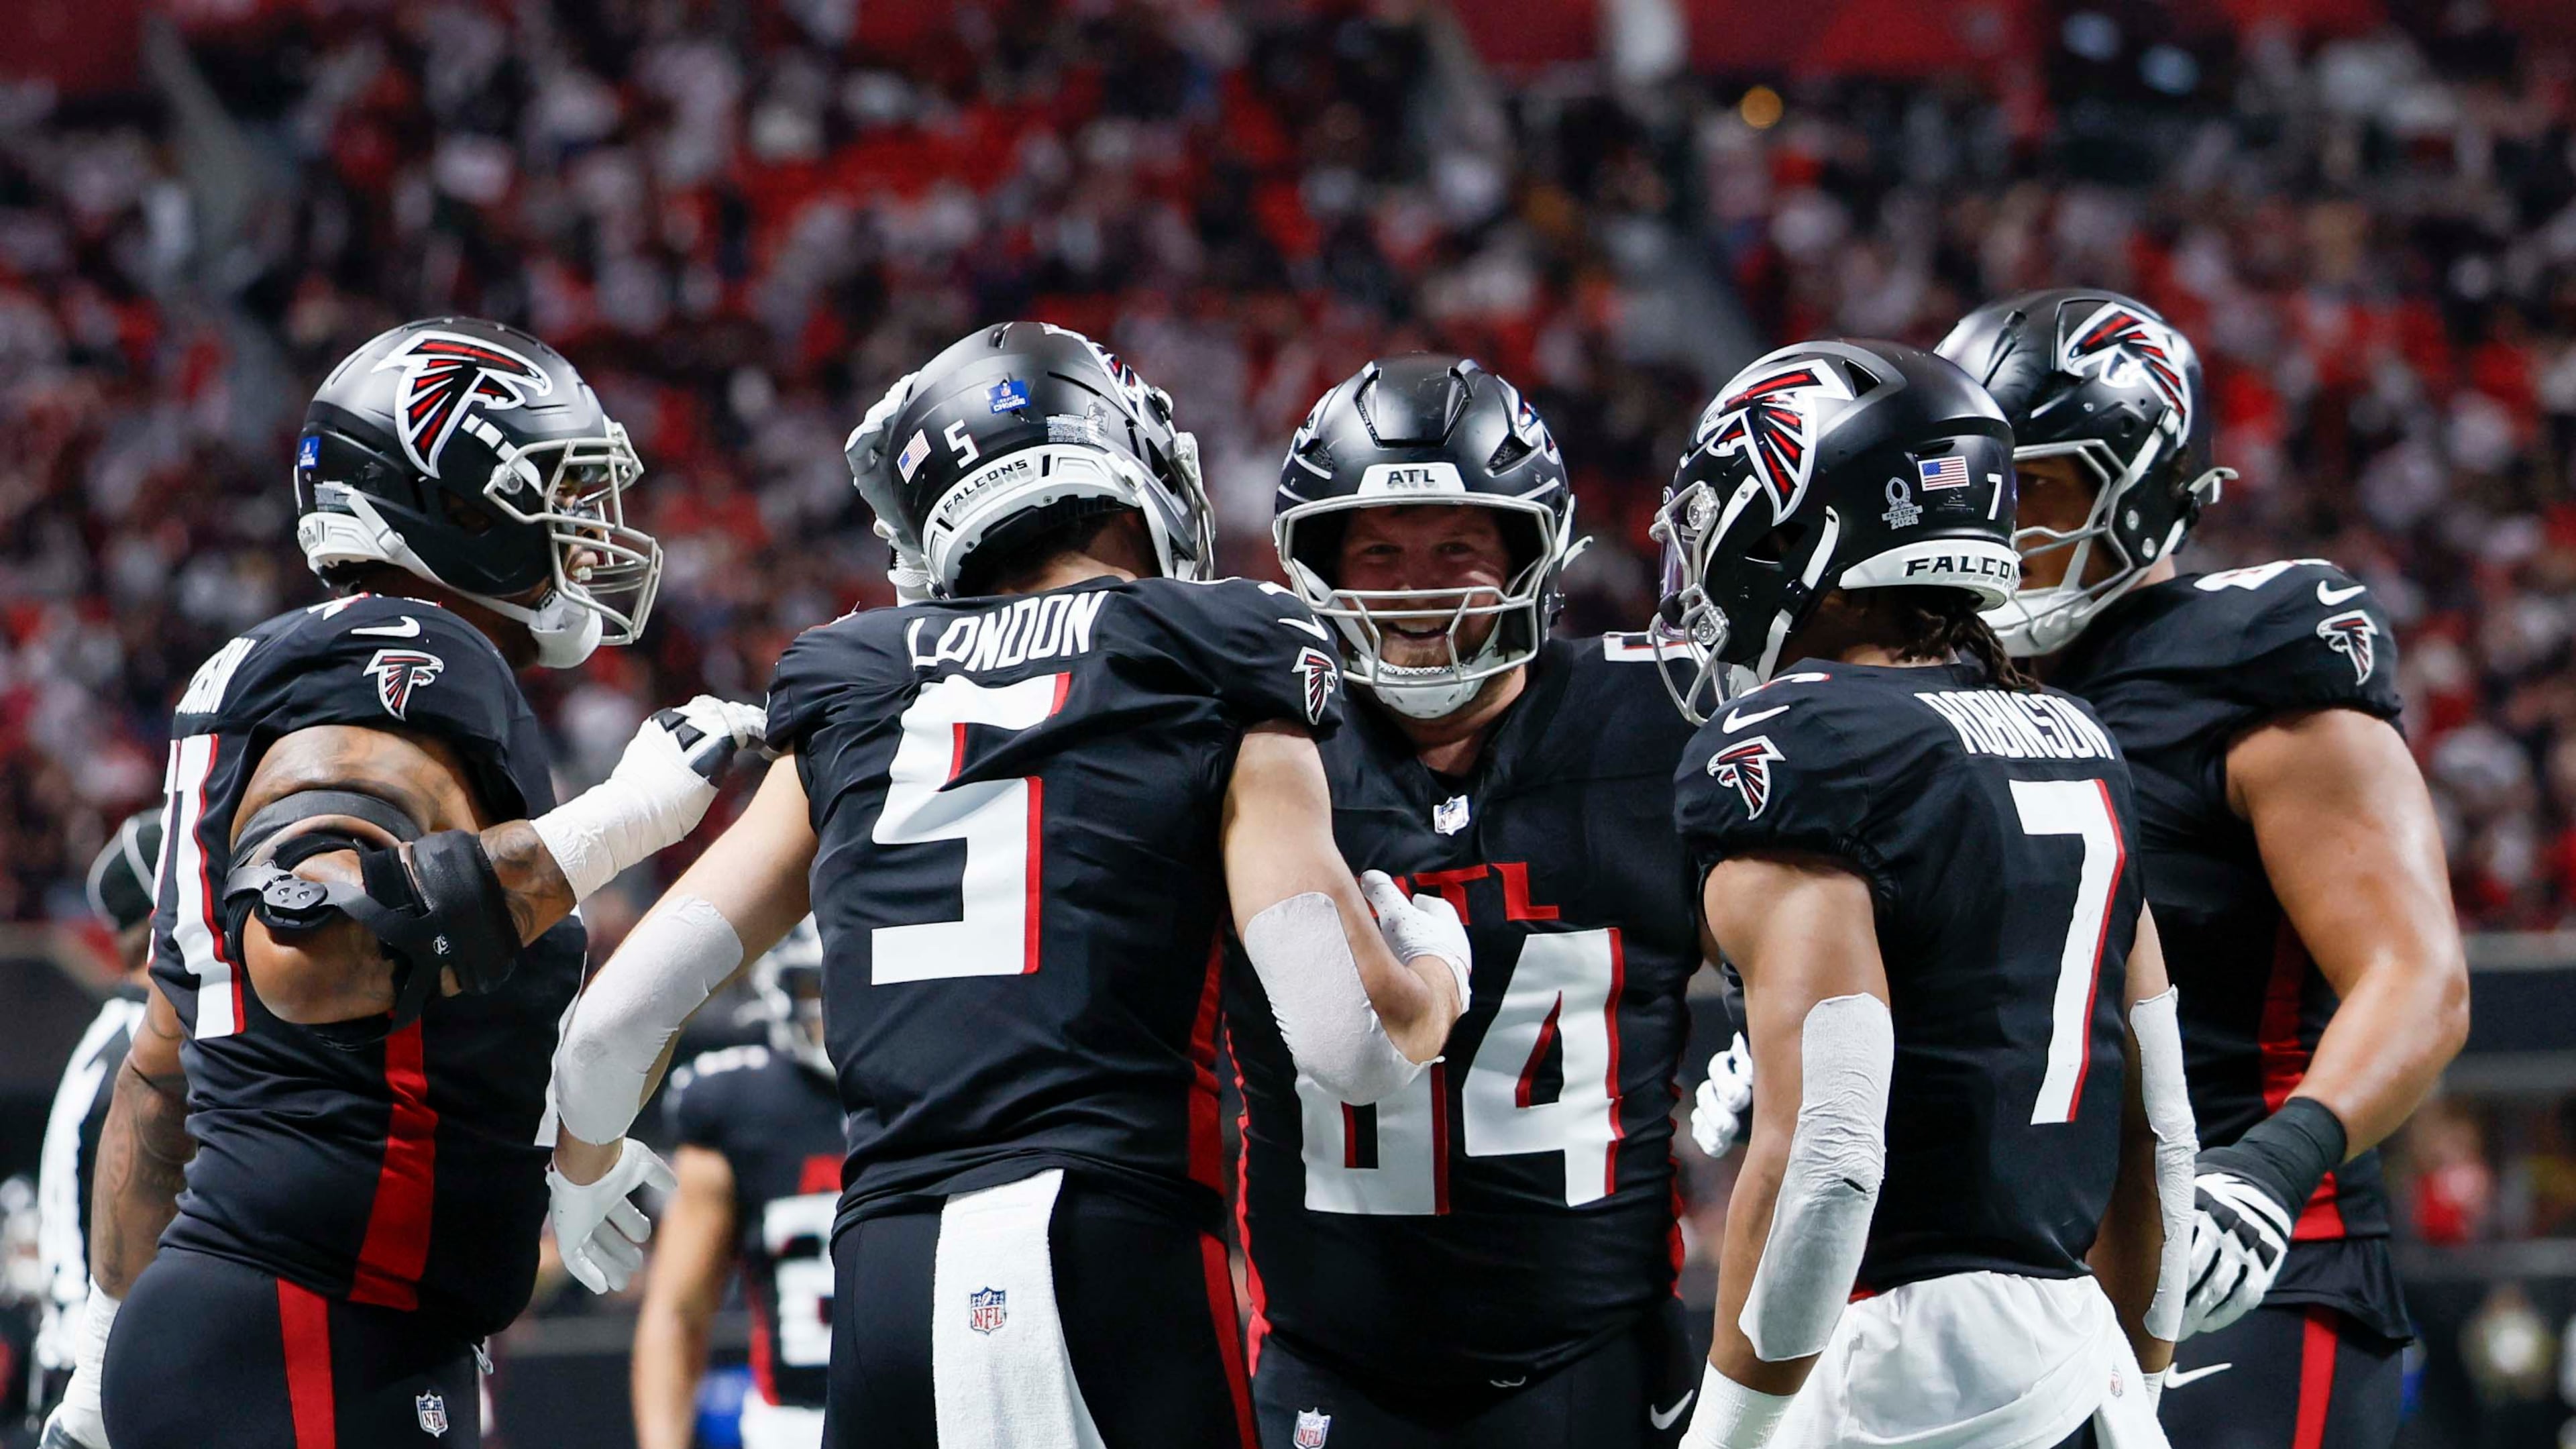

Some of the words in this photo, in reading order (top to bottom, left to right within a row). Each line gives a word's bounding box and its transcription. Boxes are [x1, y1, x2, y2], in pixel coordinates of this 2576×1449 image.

[943, 419, 979, 468] 5
[943, 459, 1028, 513] FALCONS
[1387, 469, 1436, 485] ATL
[1987, 473, 2003, 521] 7
[1890, 514, 1919, 530] 2026
[1900, 508, 1919, 516] BOWL
[1906, 555, 2021, 589] FALCON
[907, 590, 1110, 672] LONDON
[1914, 690, 2114, 760] ROBINSON
[871, 671, 1071, 986] 5
[1355, 861, 1560, 926] TL
[2008, 779, 2126, 1126] 7
[974, 1307, 1003, 1330] NFL
[423, 1411, 443, 1428] NFL
[1299, 1428, 1321, 1446] NFL
